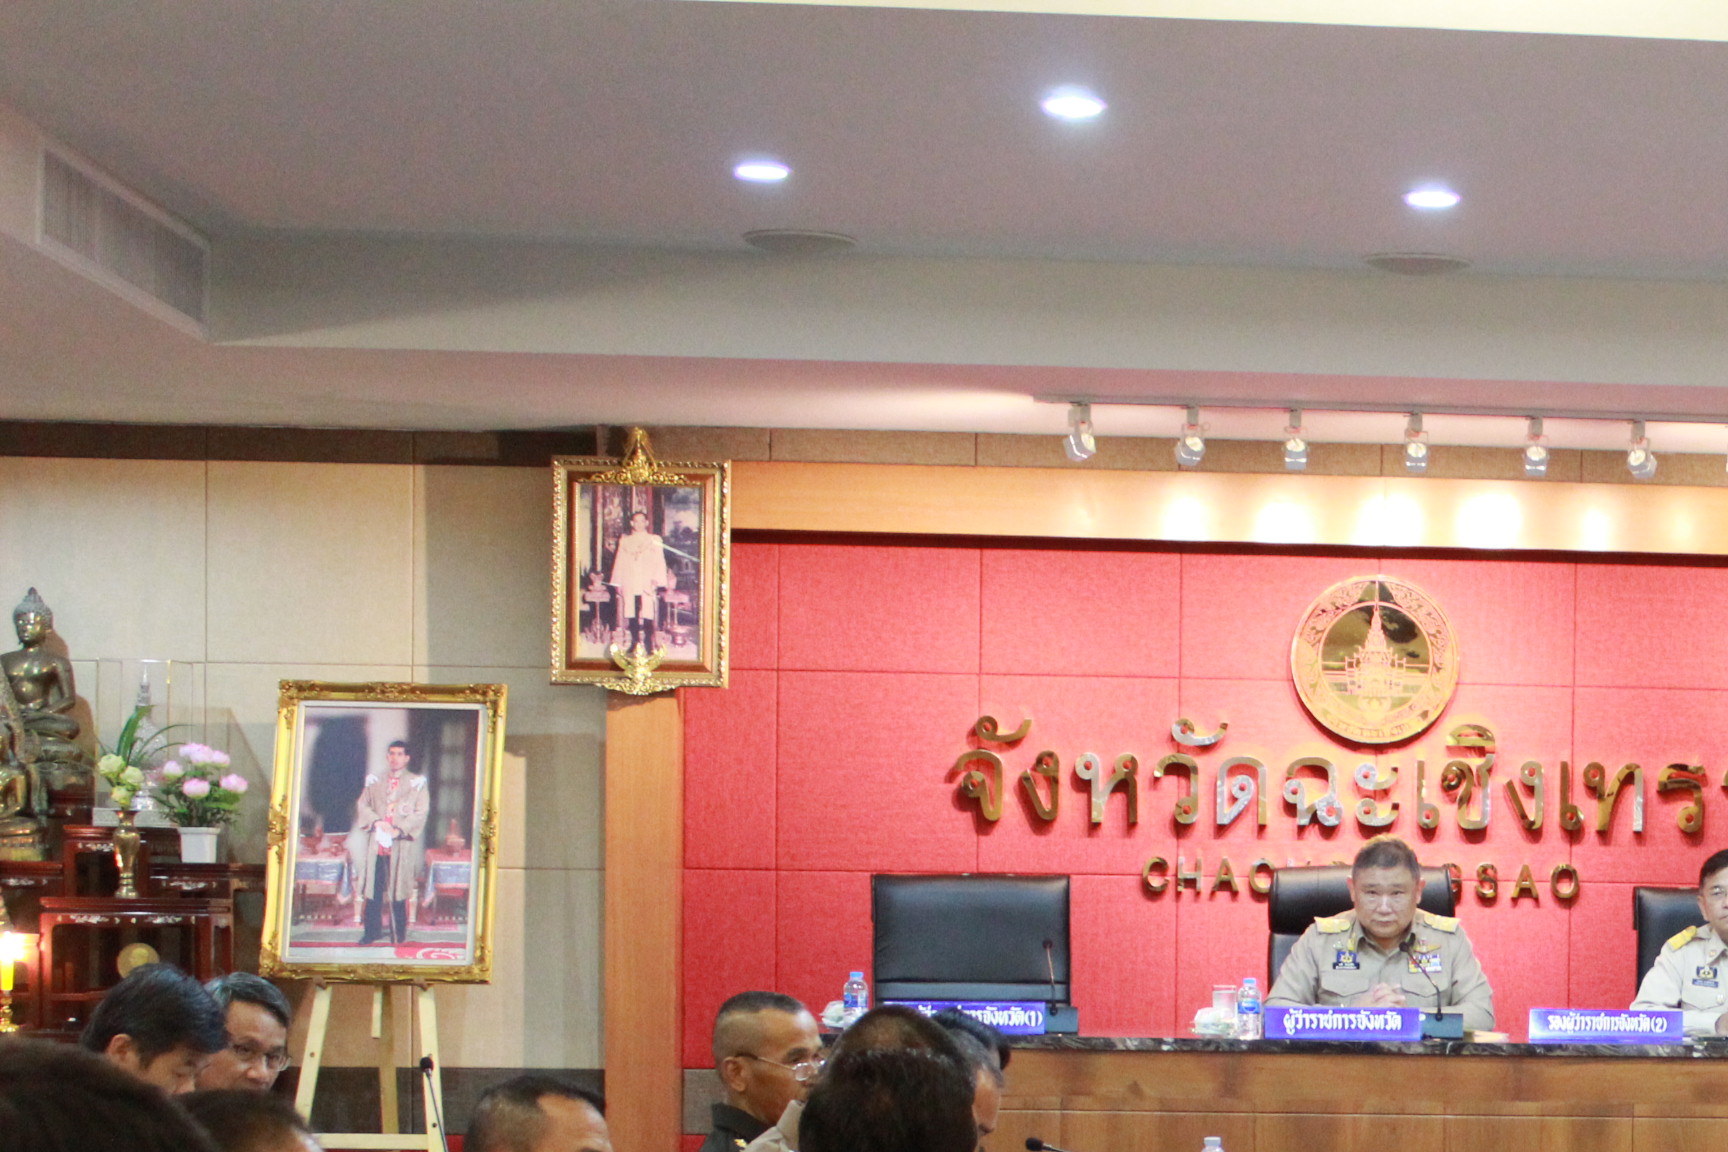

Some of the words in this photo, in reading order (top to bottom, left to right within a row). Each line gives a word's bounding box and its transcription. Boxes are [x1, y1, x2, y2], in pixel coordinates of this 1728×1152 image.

[1142, 856, 1579, 898] CHACGSAO
[1283, 1008, 1401, 1035] ผู้ว่าราชการจังหวัด
[1548, 1012, 1667, 1034] รองผู้ว่าราชการจังหวัด(2)
